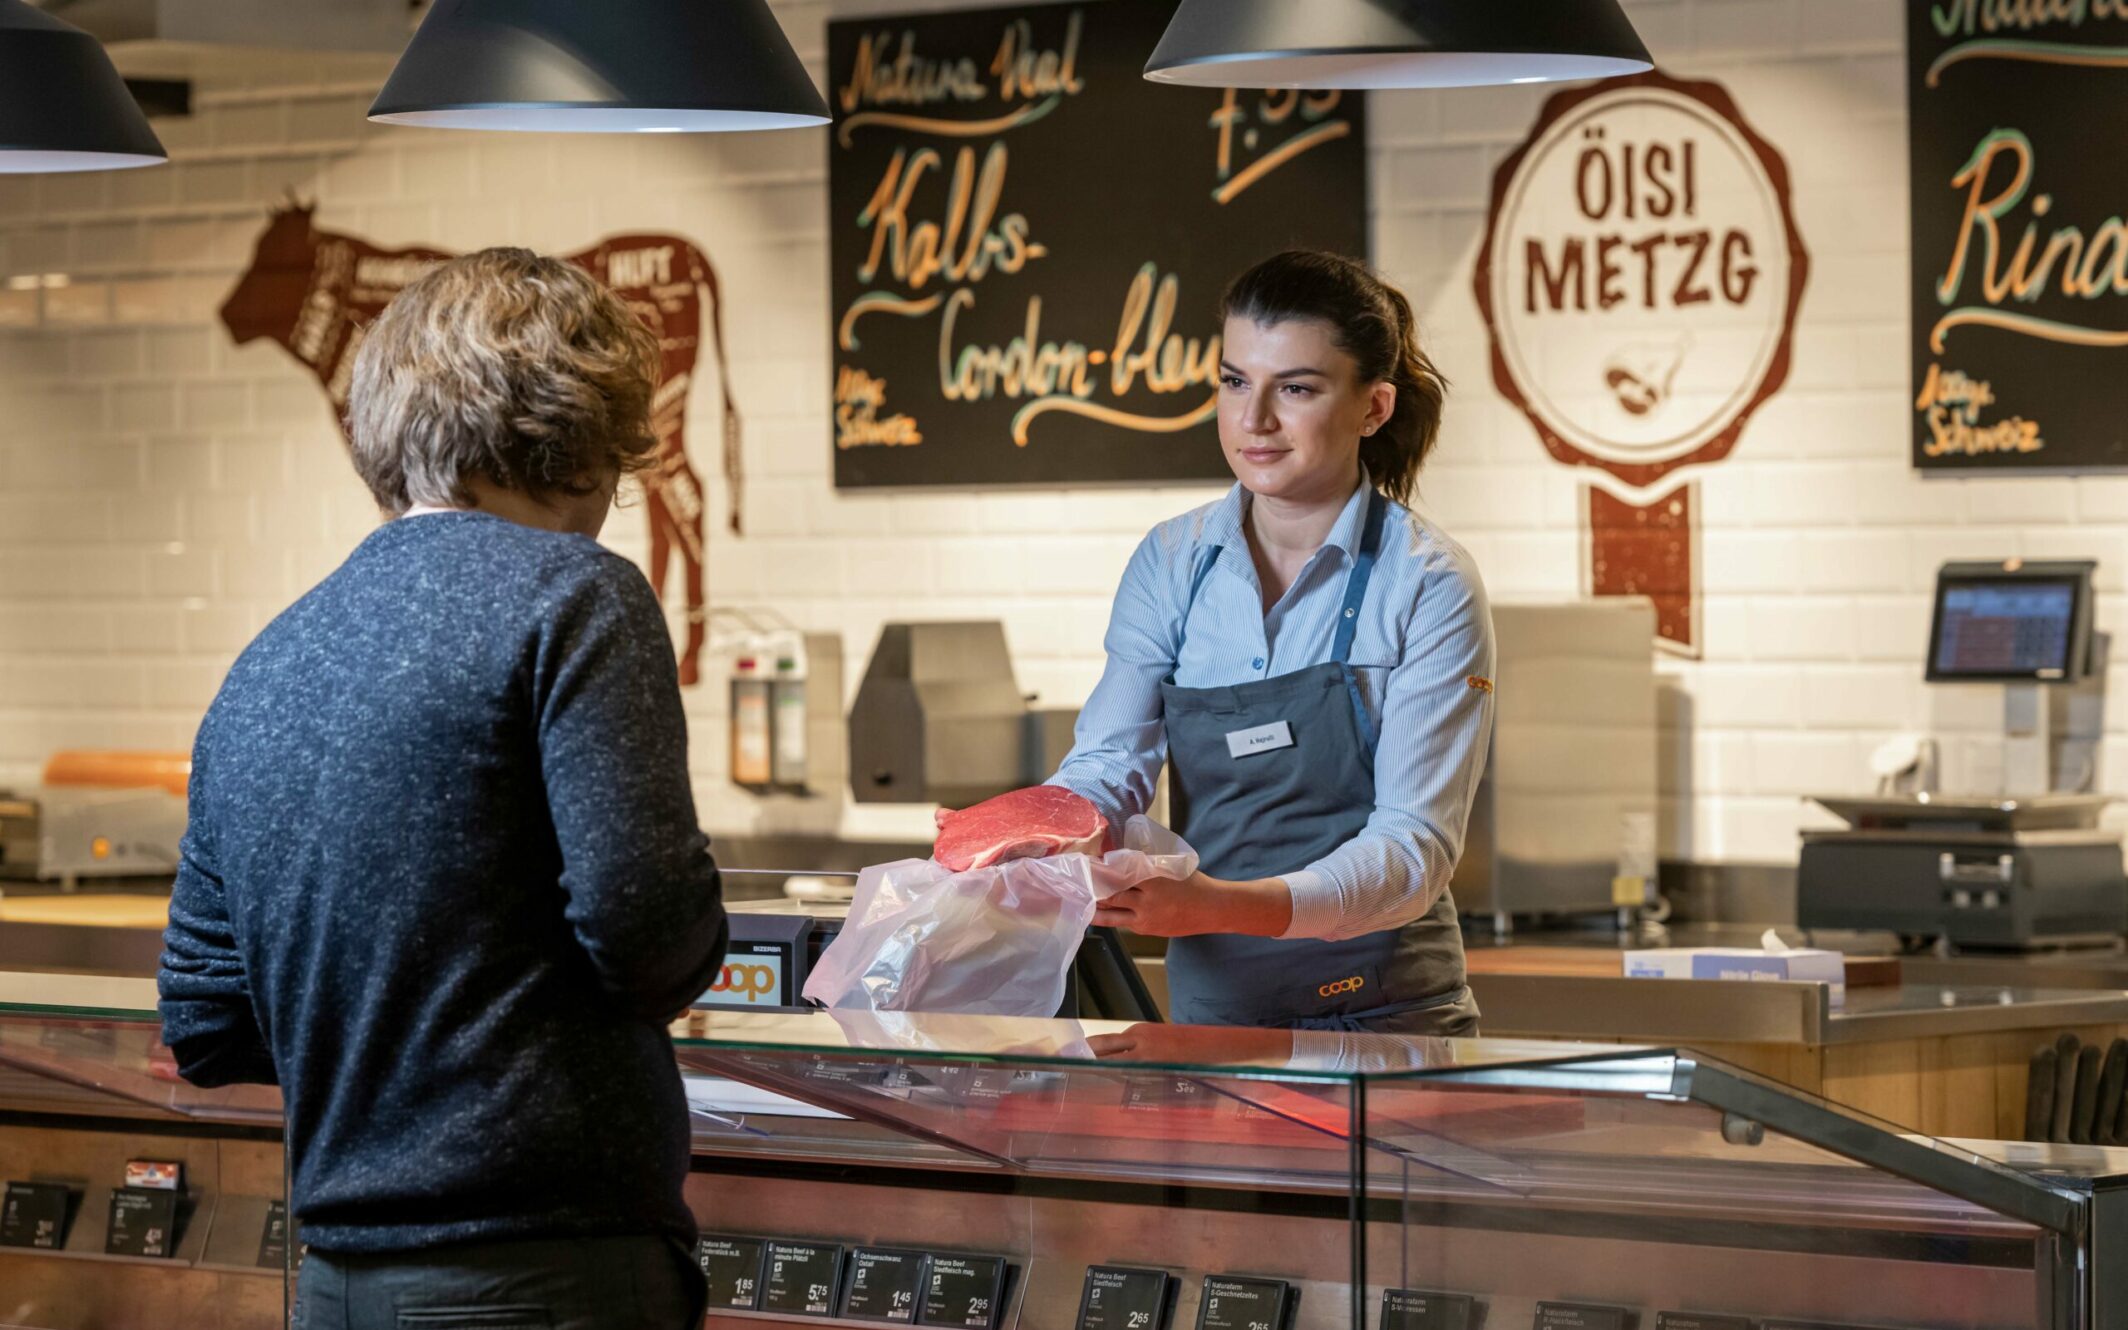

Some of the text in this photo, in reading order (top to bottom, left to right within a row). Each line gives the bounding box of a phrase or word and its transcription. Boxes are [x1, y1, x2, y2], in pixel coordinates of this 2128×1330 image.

[1575, 127, 1697, 219] ÖISI
[1525, 227, 1761, 314] METZG
[709, 963, 775, 1002] oop
[1319, 976, 1364, 997] coop
[1094, 1271, 1127, 1281] Natura Beef
[735, 1278, 753, 1295] 1.85
[808, 1284, 828, 1300] 5.75
[892, 1290, 912, 1308] 1.45
[967, 1297, 988, 1314] 2.95
[1127, 1310, 1150, 1328] 2.65
